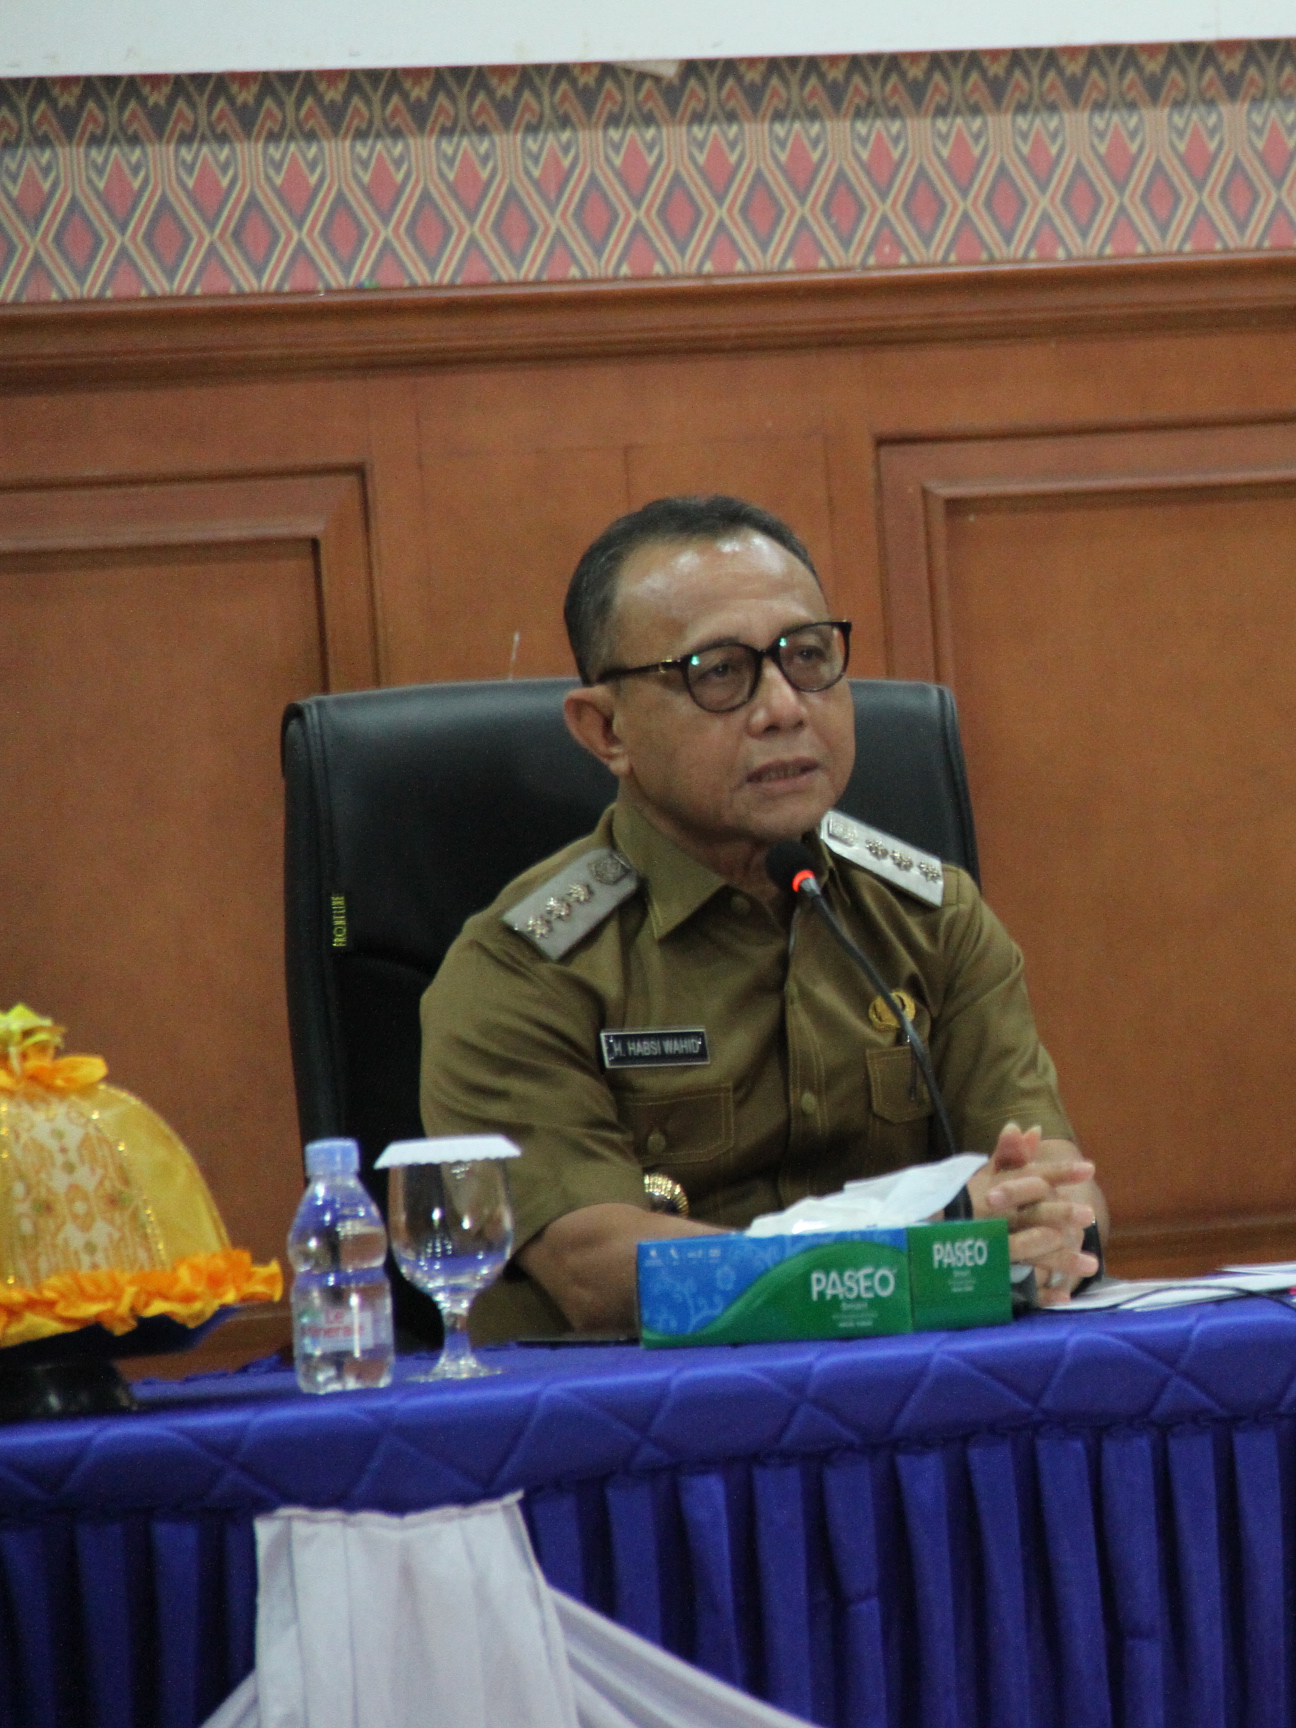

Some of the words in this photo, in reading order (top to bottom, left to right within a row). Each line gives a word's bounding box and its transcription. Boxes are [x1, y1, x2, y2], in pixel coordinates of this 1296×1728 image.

[331, 896, 346, 946] FRONTLINE
[627, 1039, 661, 1056] HABSI
[662, 1038, 700, 1055] WAHID
[933, 1239, 988, 1269] PASEO
[811, 1268, 895, 1301] PASEO
